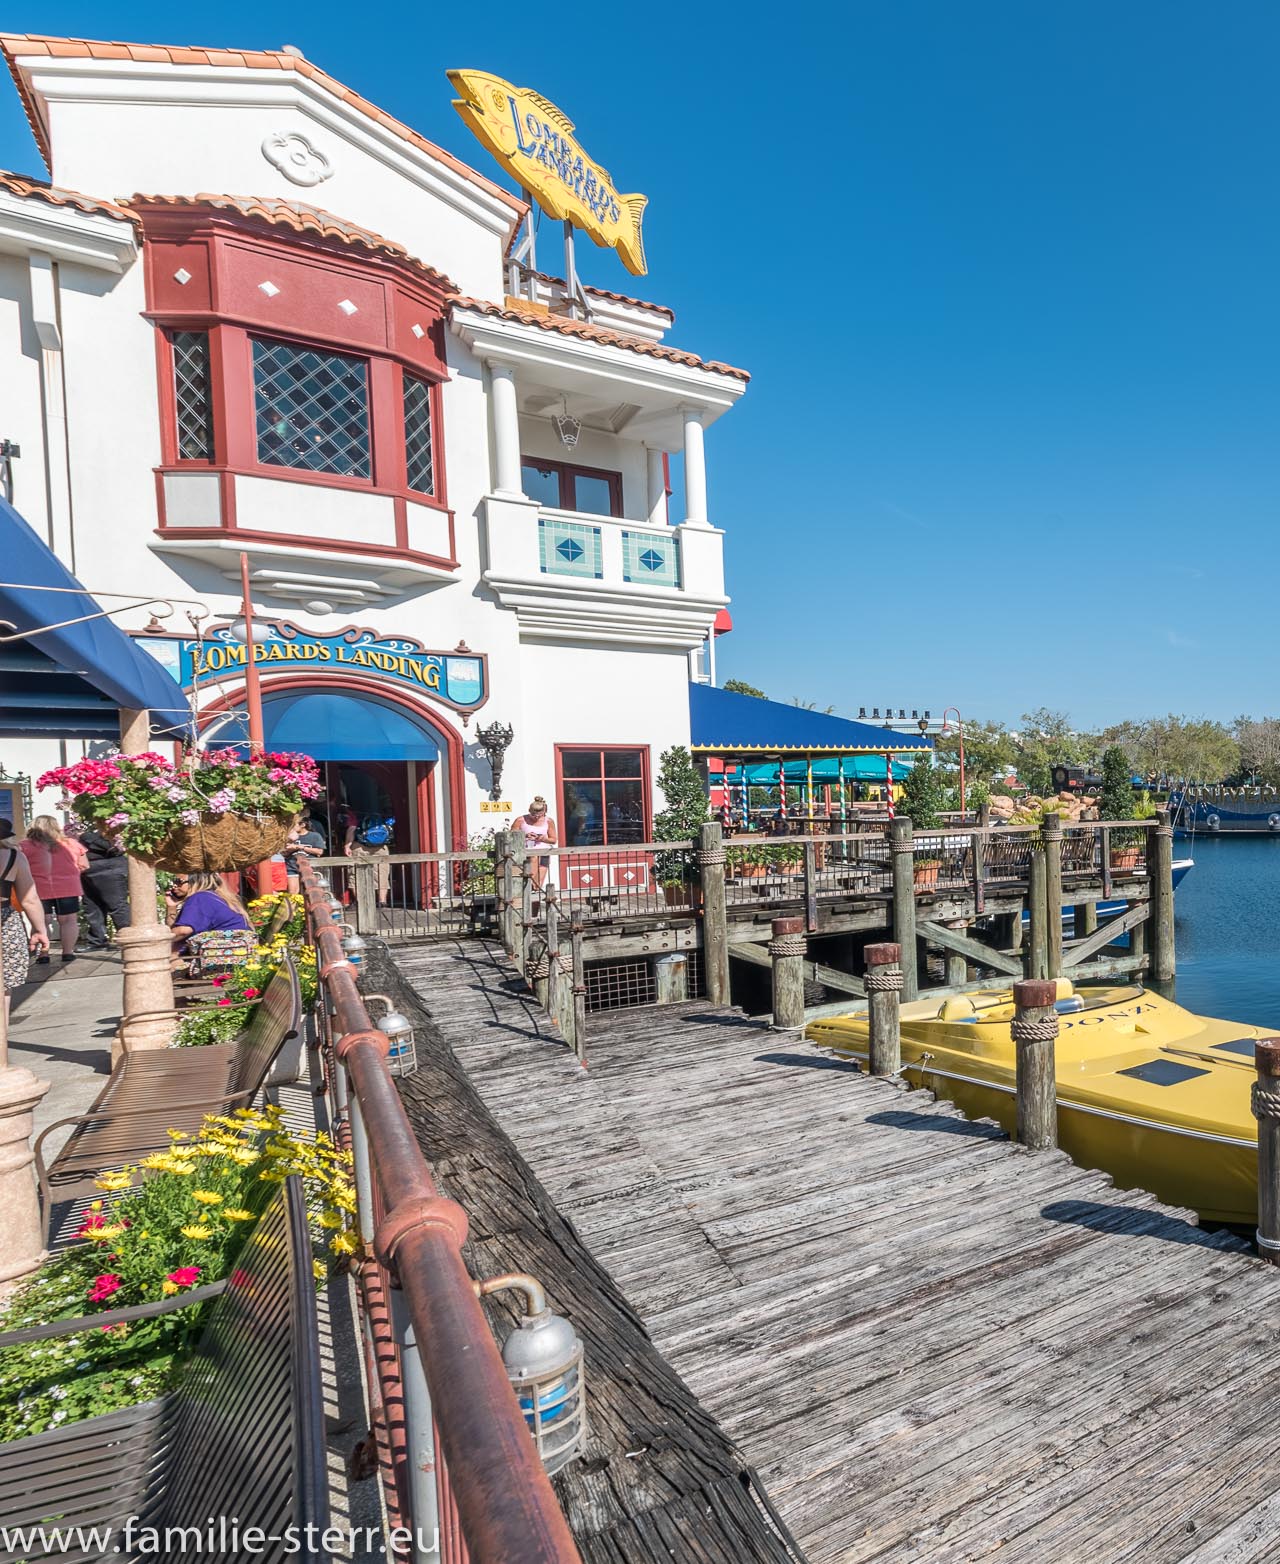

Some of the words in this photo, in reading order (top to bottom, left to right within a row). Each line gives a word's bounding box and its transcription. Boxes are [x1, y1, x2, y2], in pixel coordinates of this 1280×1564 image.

[507, 96, 622, 224] LOMBARD'S
[190, 641, 331, 678] LOMBARD'S
[335, 646, 441, 691] LANDING
